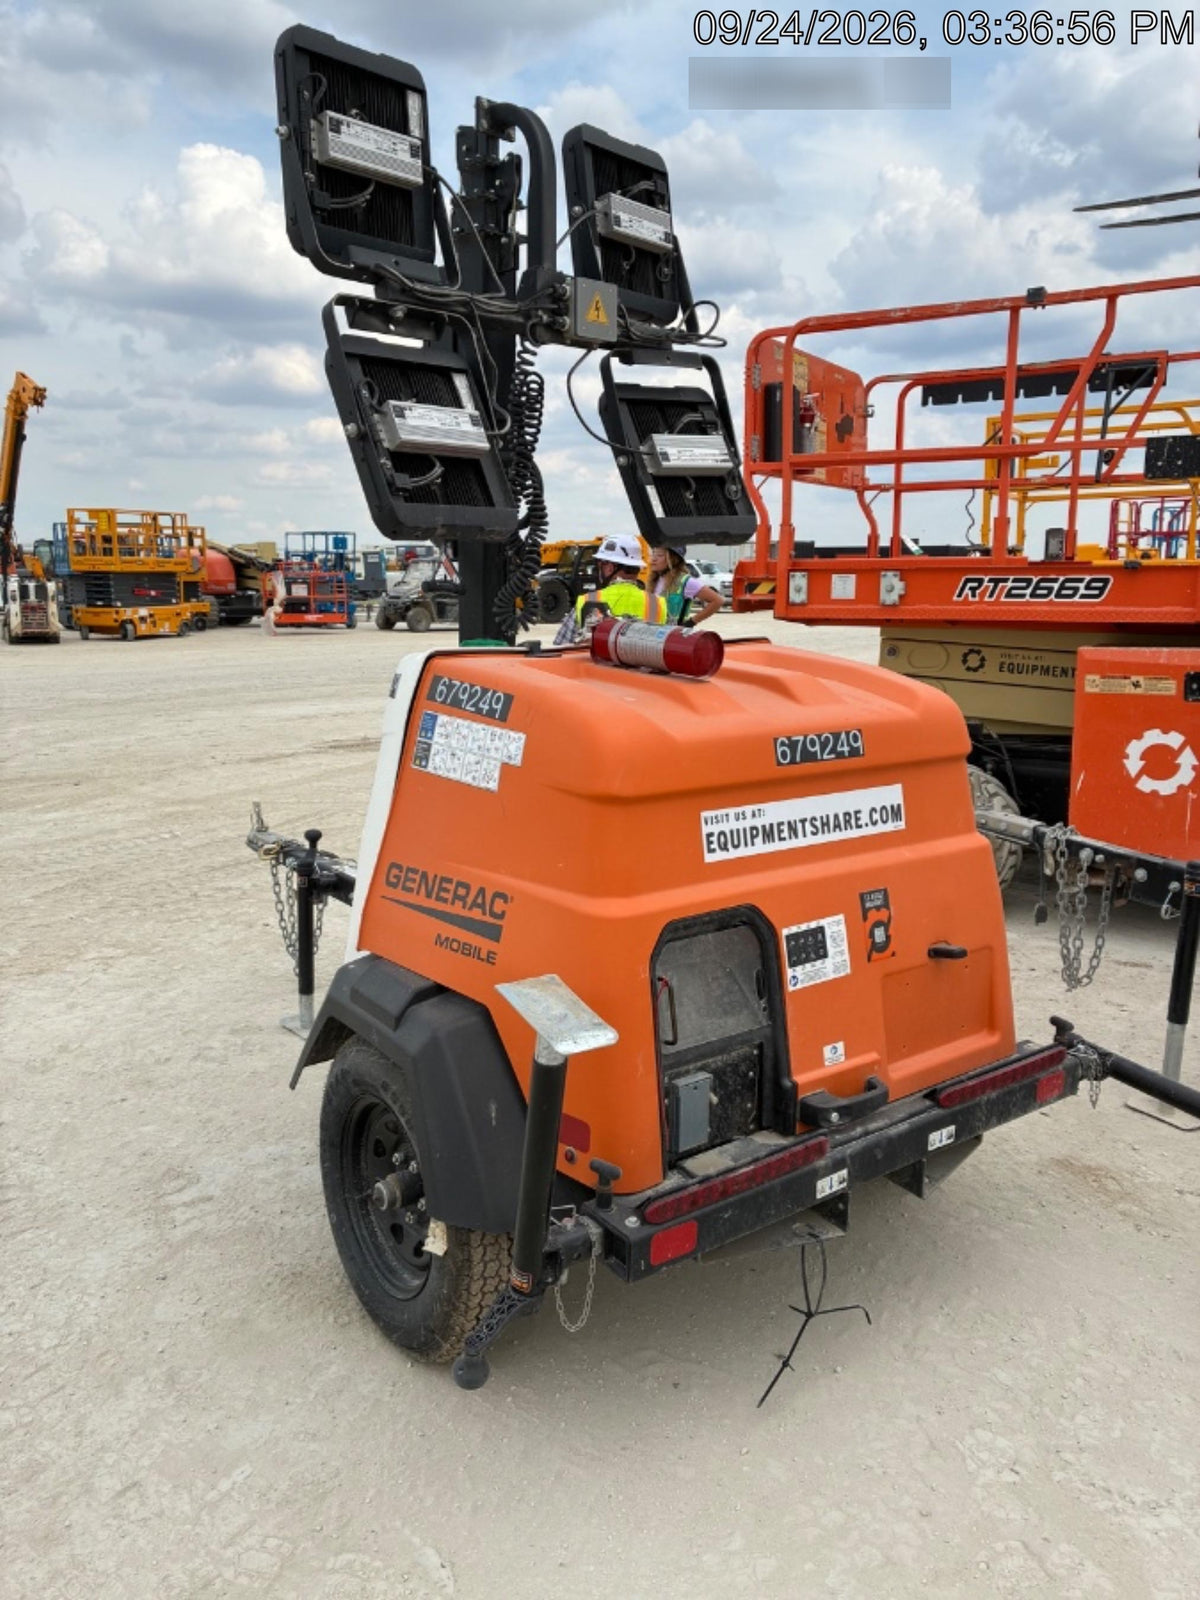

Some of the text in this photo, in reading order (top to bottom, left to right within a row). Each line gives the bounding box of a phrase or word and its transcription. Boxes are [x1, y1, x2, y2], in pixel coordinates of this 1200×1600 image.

[953, 574, 1114, 602] RT2669
[435, 676, 505, 719] 679249
[775, 729, 864, 764] 679249
[703, 808, 766, 826] VISIT US AT:
[705, 803, 903, 854] EQUIPMENTSHARE.COM
[385, 861, 509, 920] GENERAC
[434, 933, 498, 966] MOBILE
